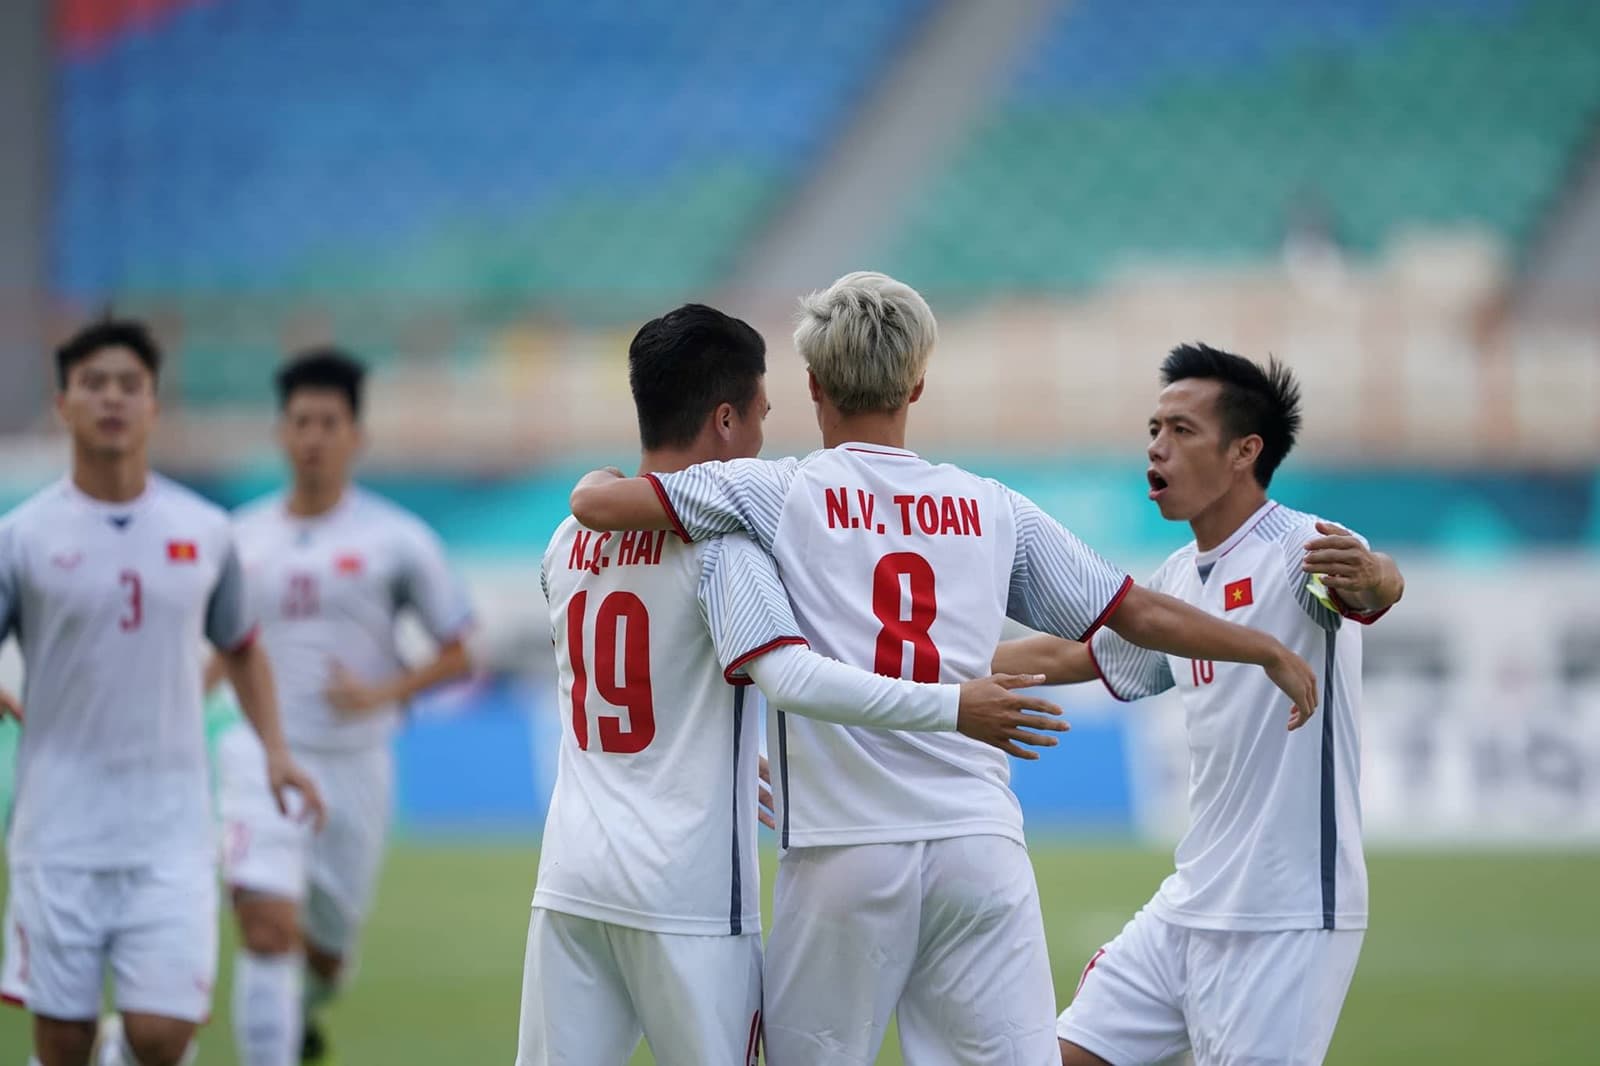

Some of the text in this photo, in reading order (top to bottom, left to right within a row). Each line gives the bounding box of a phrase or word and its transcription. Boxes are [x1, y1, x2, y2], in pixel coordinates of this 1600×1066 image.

[825, 486, 982, 536] N.V. TOAN
[617, 529, 667, 566] HAI
[118, 569, 143, 633] 3
[872, 551, 941, 684] 8
[567, 590, 656, 754] 19
